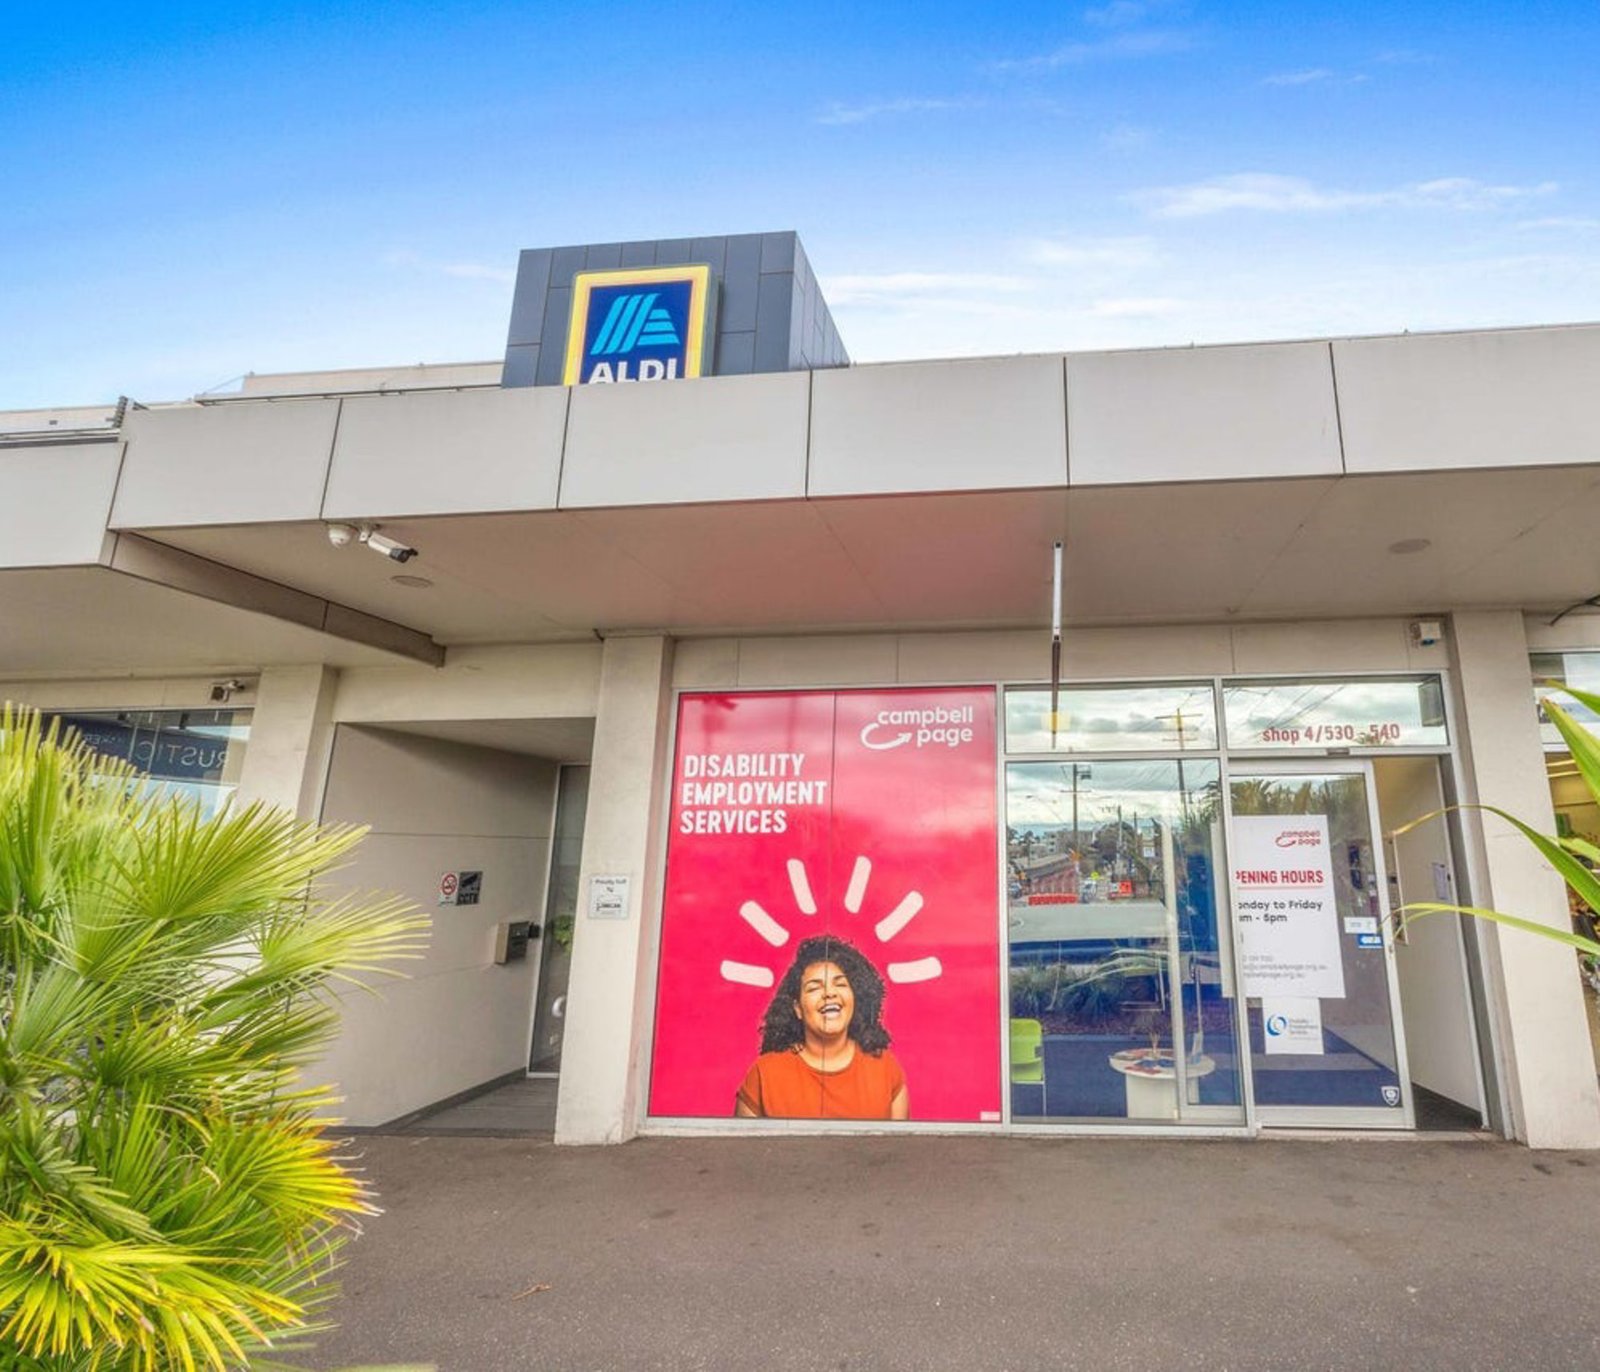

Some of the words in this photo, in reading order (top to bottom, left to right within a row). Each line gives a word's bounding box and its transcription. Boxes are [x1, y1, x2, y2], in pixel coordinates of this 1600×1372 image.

[588, 358, 677, 384] ALDI
[877, 706, 973, 727] campbell
[916, 726, 973, 747] page
[1262, 727, 1300, 746] shop
[1304, 725, 1354, 743] 4/530
[1369, 724, 1400, 742] 540
[684, 753, 805, 778] DISABILITY
[681, 780, 827, 806] EMPLOYMENT
[680, 809, 788, 834] SERVICES
[1281, 870, 1324, 883] HOURS
[1274, 901, 1286, 909] to
[1289, 900, 1323, 911] Friday
